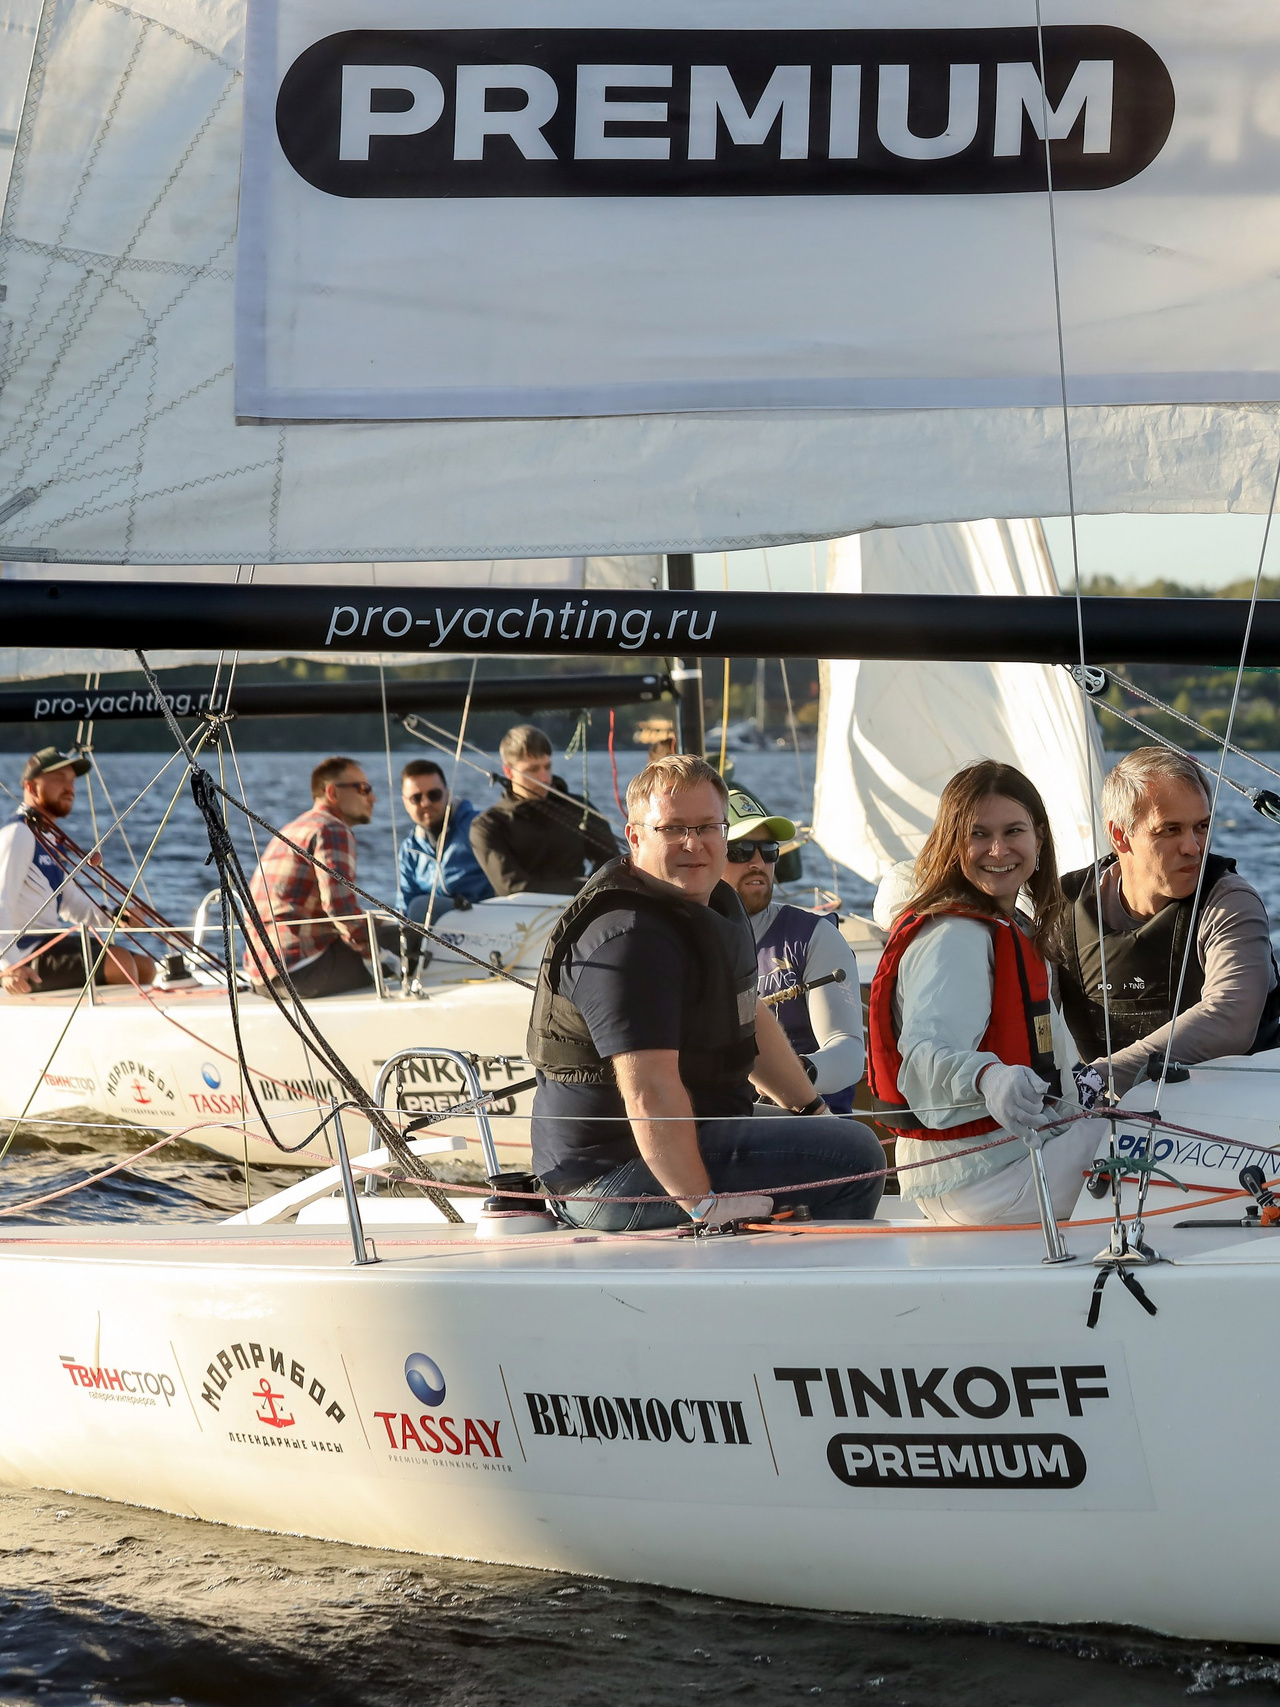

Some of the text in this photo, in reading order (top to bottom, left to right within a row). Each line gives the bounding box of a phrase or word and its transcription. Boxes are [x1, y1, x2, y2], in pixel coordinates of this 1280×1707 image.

[338, 59, 1116, 161] PREMIUM
[325, 598, 718, 650] pro-yachting.ru
[189, 1094, 250, 1115] TASSAY
[201, 1342, 346, 1424] МОРПРИБОР
[773, 1365, 1110, 1420] TINKOFF
[229, 1432, 344, 1454] ЛЕГЕНДАРНЫЕ ЧАСЫ
[373, 1411, 504, 1458] TASSAY
[523, 1392, 752, 1446] ВЕДОМОСТИ
[388, 1454, 513, 1473] PREMIUM DRINKING WATER
[841, 1443, 1071, 1479] PREMIUM
